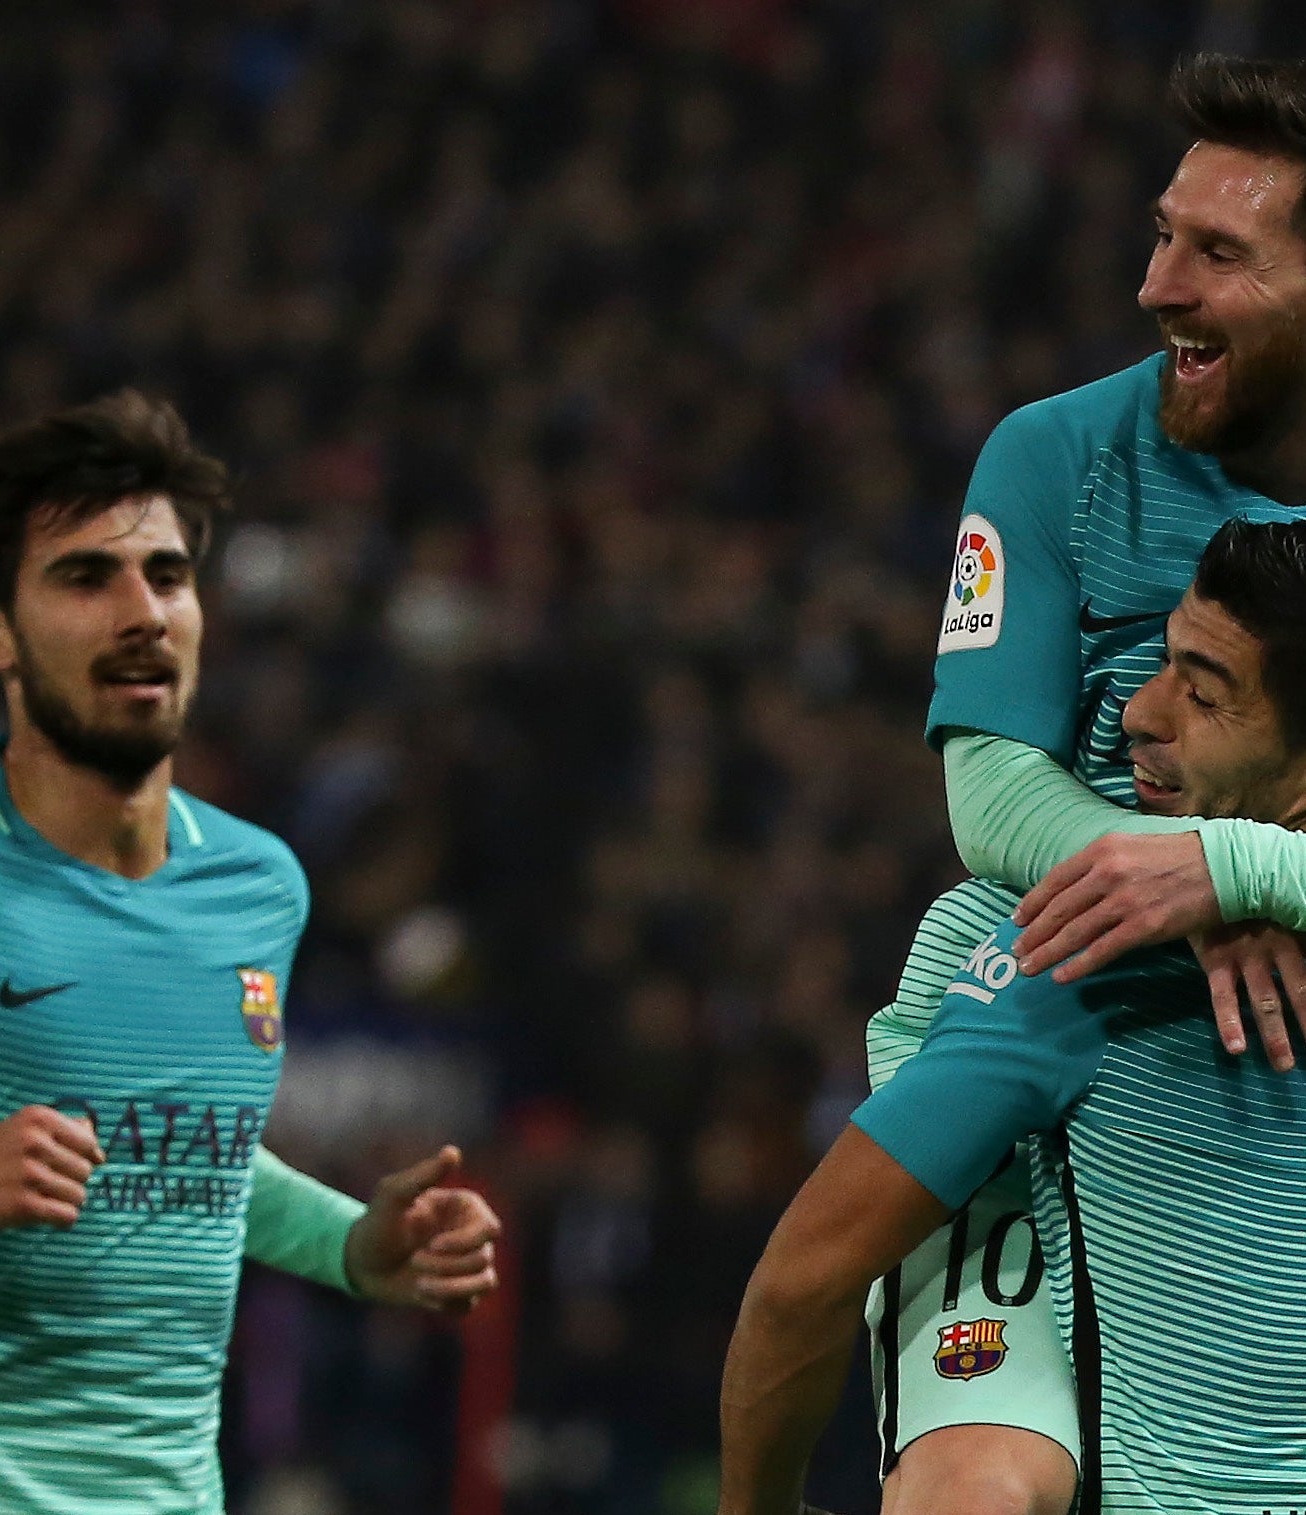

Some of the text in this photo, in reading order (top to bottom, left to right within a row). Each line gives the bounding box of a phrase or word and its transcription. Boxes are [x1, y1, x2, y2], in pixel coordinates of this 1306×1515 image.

[944, 610, 994, 635] LaLiga
[960, 932, 1018, 990] ko
[942, 1210, 1045, 1313] 10
